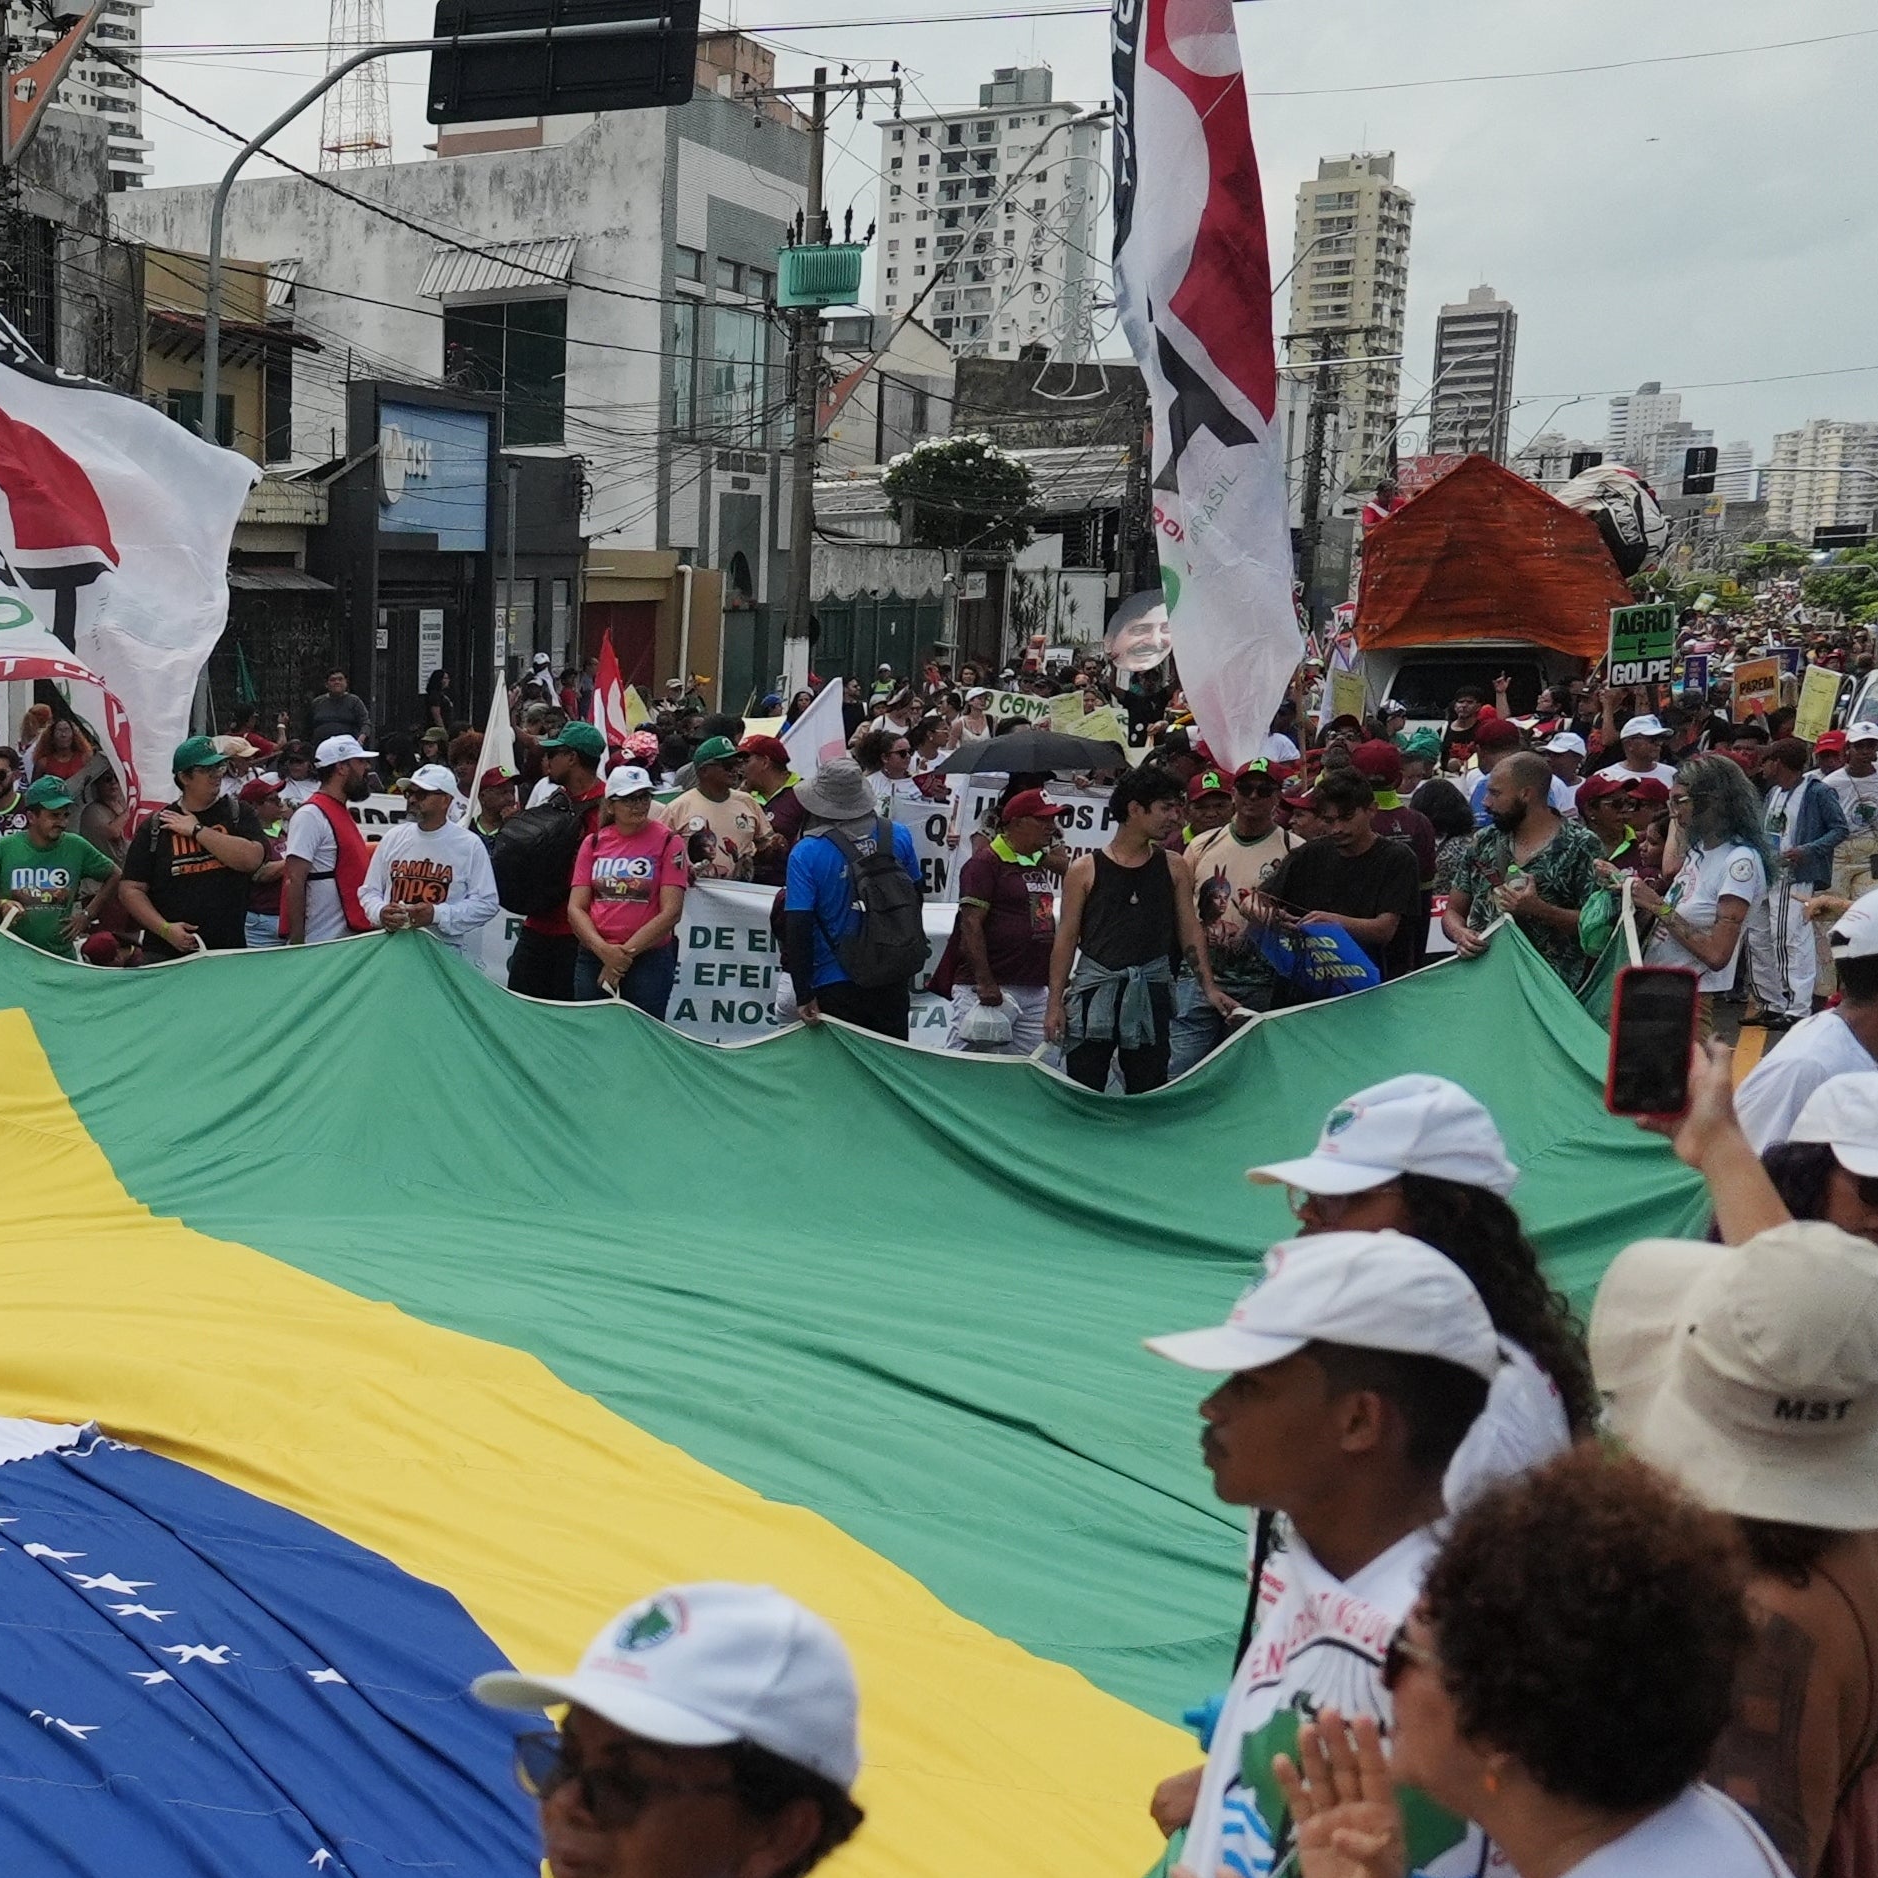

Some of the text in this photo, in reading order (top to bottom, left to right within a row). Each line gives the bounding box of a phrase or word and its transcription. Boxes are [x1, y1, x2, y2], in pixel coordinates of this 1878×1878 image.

[1615, 607, 1671, 636] AGRO
[1611, 660, 1671, 686] GOLPE
[12, 868, 70, 890] MP3
[391, 858, 453, 882] FAMÍLIA
[592, 856, 652, 880] MP3
[689, 926, 735, 950] DE
[674, 998, 698, 1021] A
[1773, 1399, 1853, 1421] MST
